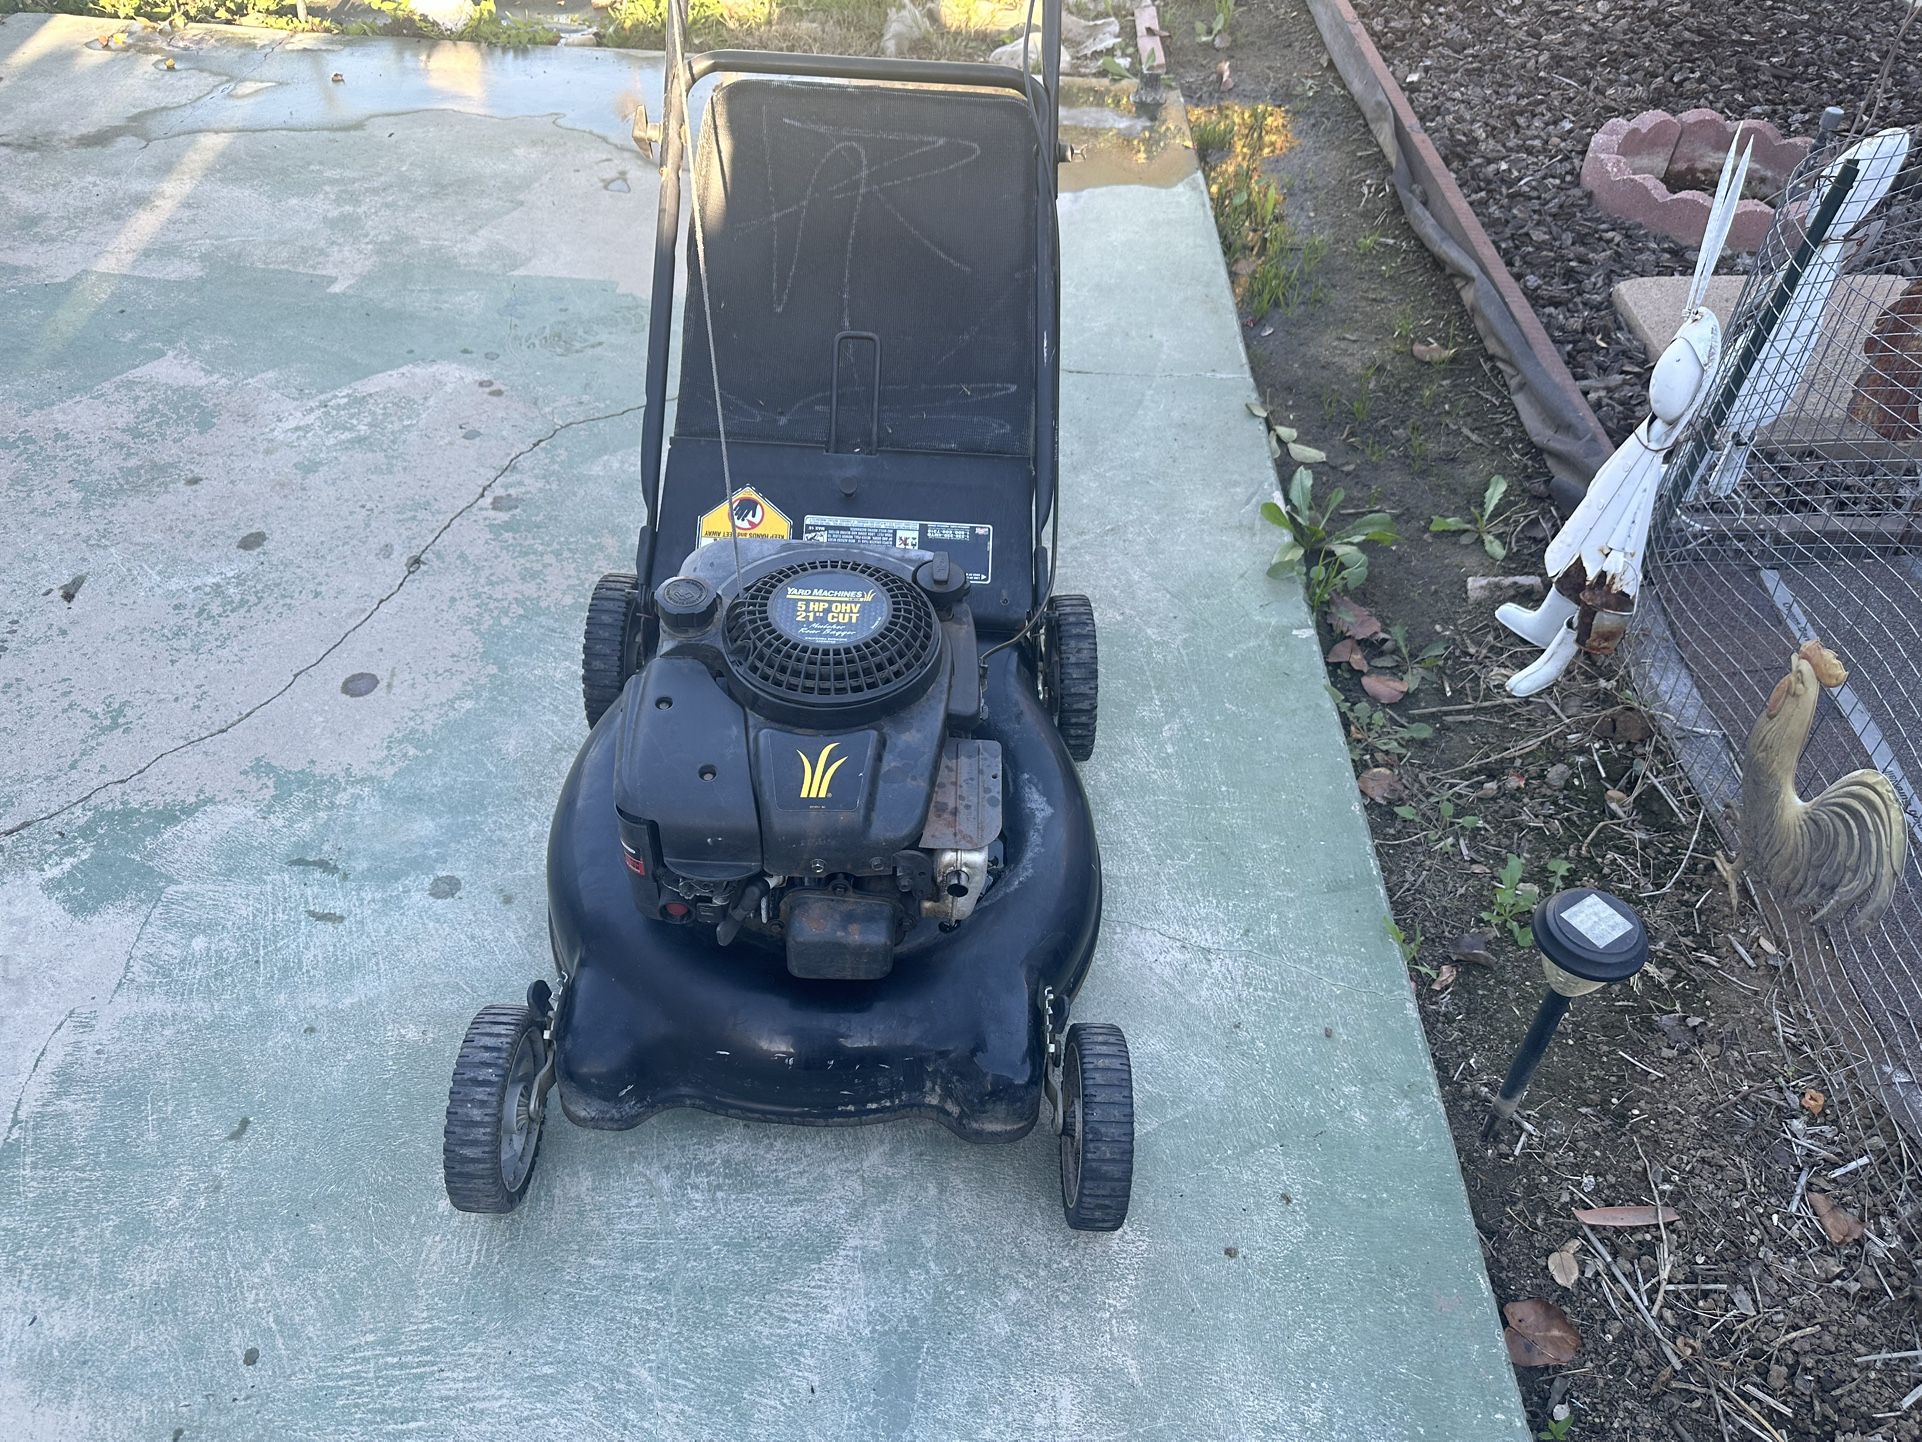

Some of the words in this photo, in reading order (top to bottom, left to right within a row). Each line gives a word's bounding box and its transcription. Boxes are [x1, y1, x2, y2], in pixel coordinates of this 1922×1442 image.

[787, 587, 811, 595] YARD
[812, 588, 862, 598] MACHINES
[797, 601, 806, 611] 5
[809, 602, 828, 611] HP
[831, 602, 861, 613] OHV
[796, 611, 823, 621] 21"
[827, 613, 860, 623] CUT
[822, 629, 856, 637] Bagger
